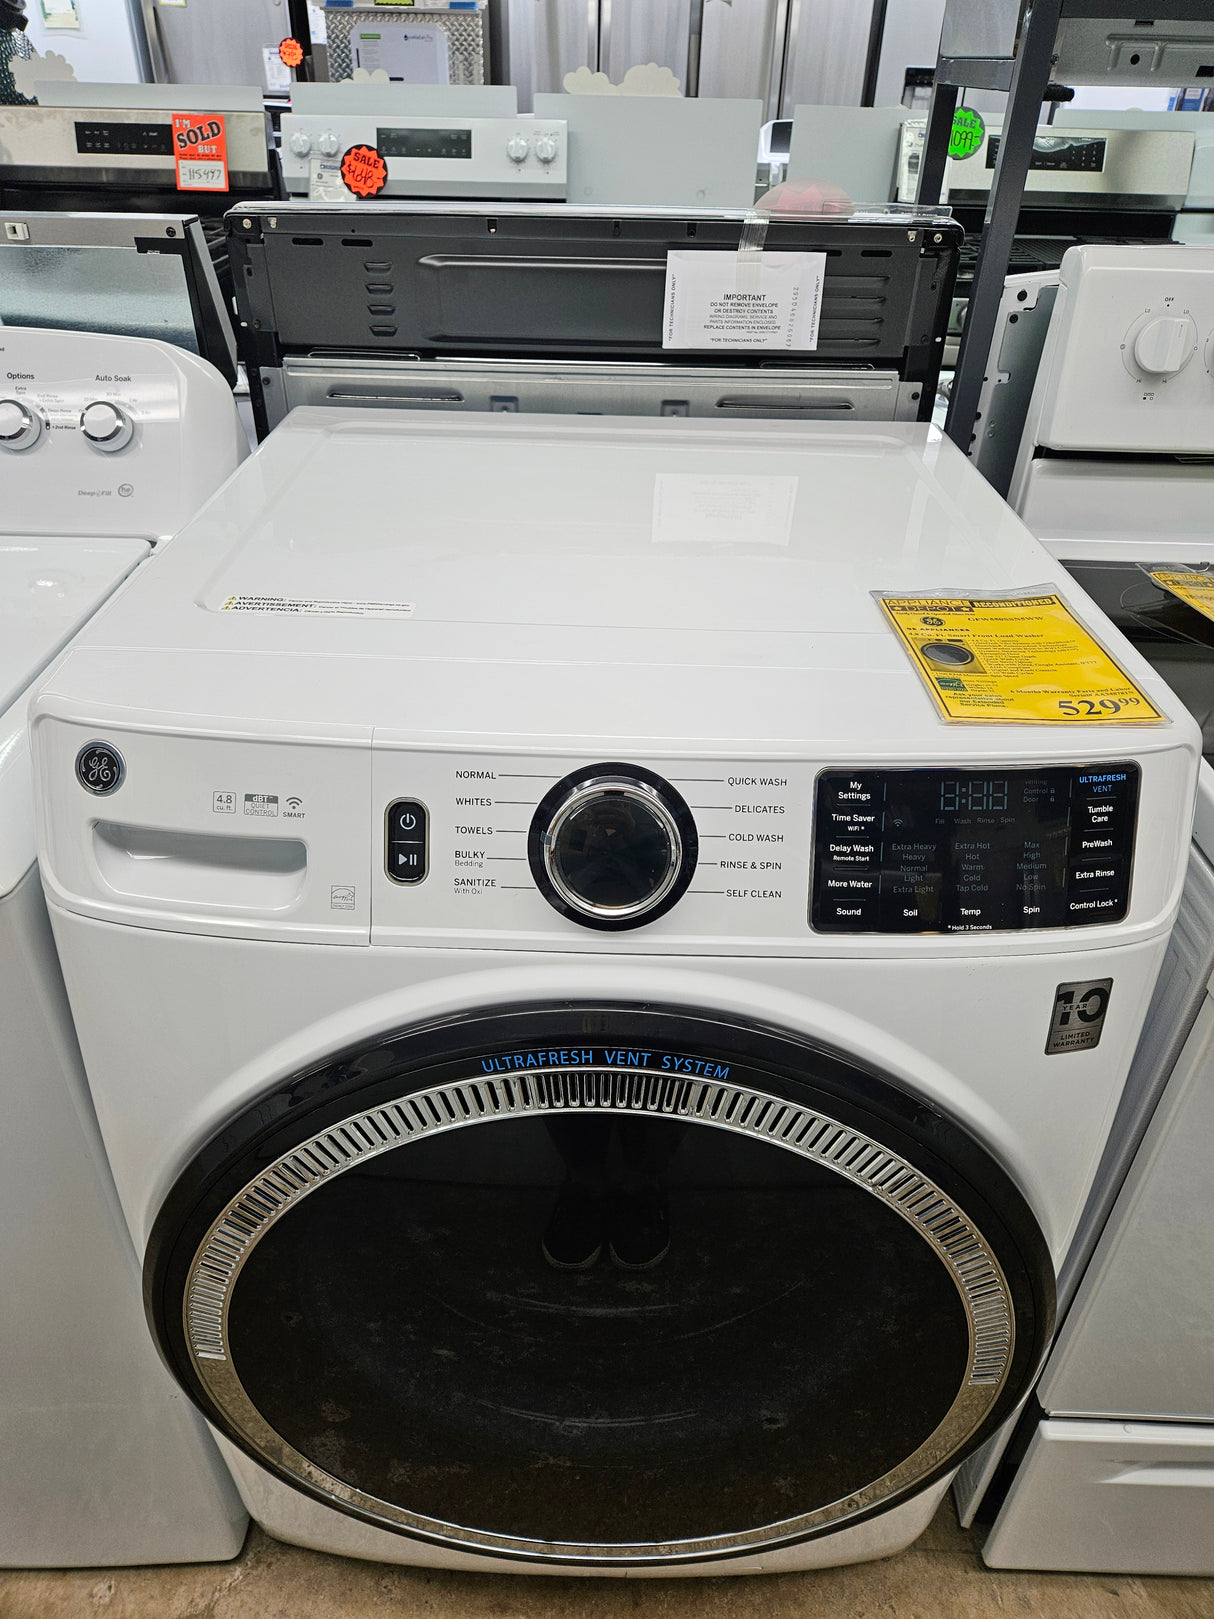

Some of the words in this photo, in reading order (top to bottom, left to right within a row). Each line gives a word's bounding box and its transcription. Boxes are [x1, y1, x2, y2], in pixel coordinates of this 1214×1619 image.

[175, 119, 191, 128] I'M
[176, 121, 222, 149] SOLD
[198, 145, 217, 153] BUT
[354, 152, 380, 168] SALE
[810, 293, 818, 328] TECHNICIANS
[6, 372, 35, 380] Options
[973, 598, 1053, 608] RECONDITIONED
[455, 770, 496, 780] NORMAL
[1078, 774, 1127, 784] ULTRAFRESH
[727, 777, 758, 786] QUICK
[760, 778, 788, 786] WASH
[850, 782, 862, 790] My
[1092, 784, 1112, 792] VENT
[216, 794, 233, 804] 4.8
[838, 792, 871, 802] Settings
[455, 798, 492, 806] WHITES
[734, 805, 786, 814] DELICATES
[1088, 805, 1114, 814] Tumble
[831, 814, 851, 822] Time
[852, 814, 876, 822] Saver
[1000, 816, 1016, 824] Spin
[1091, 815, 1109, 824] Care
[454, 826, 493, 834] TOWELS
[728, 834, 754, 842] COLD
[756, 834, 784, 842] WASH
[829, 844, 852, 853] Delay
[852, 844, 874, 852] Wash
[913, 844, 937, 852] Heavy
[1082, 840, 1113, 848] PreWash
[454, 850, 486, 859] BULKY
[902, 854, 926, 862] Heavy
[1023, 852, 1041, 860] High
[454, 860, 484, 868] Bedding
[720, 860, 748, 869] RINSE
[760, 862, 782, 870] SPIN
[904, 874, 924, 882] Light
[1076, 872, 1094, 880] Extra
[1095, 870, 1115, 878] Rinse
[454, 878, 496, 887] SANITIZE
[828, 880, 848, 888] More
[849, 880, 873, 889] Water
[914, 885, 934, 894] Light
[956, 884, 970, 892] Tap
[1028, 884, 1046, 892] Spin
[726, 890, 749, 898] SELF
[750, 890, 782, 898] CLEAN
[1070, 901, 1096, 910] Control
[1096, 900, 1114, 908] Lock
[903, 908, 918, 917] Soil
[960, 908, 982, 916] Temp
[1022, 906, 1041, 915] Spin
[1056, 988, 1110, 1026] 10
[1062, 1004, 1088, 1012] YEAR
[1060, 1031, 1090, 1041] LIMITED
[1053, 1036, 1095, 1048] WARRANTY
[481, 1050, 594, 1074] ULTRAFRESH
[604, 1050, 652, 1067] VENT
[661, 1055, 730, 1080] SYSTEM
